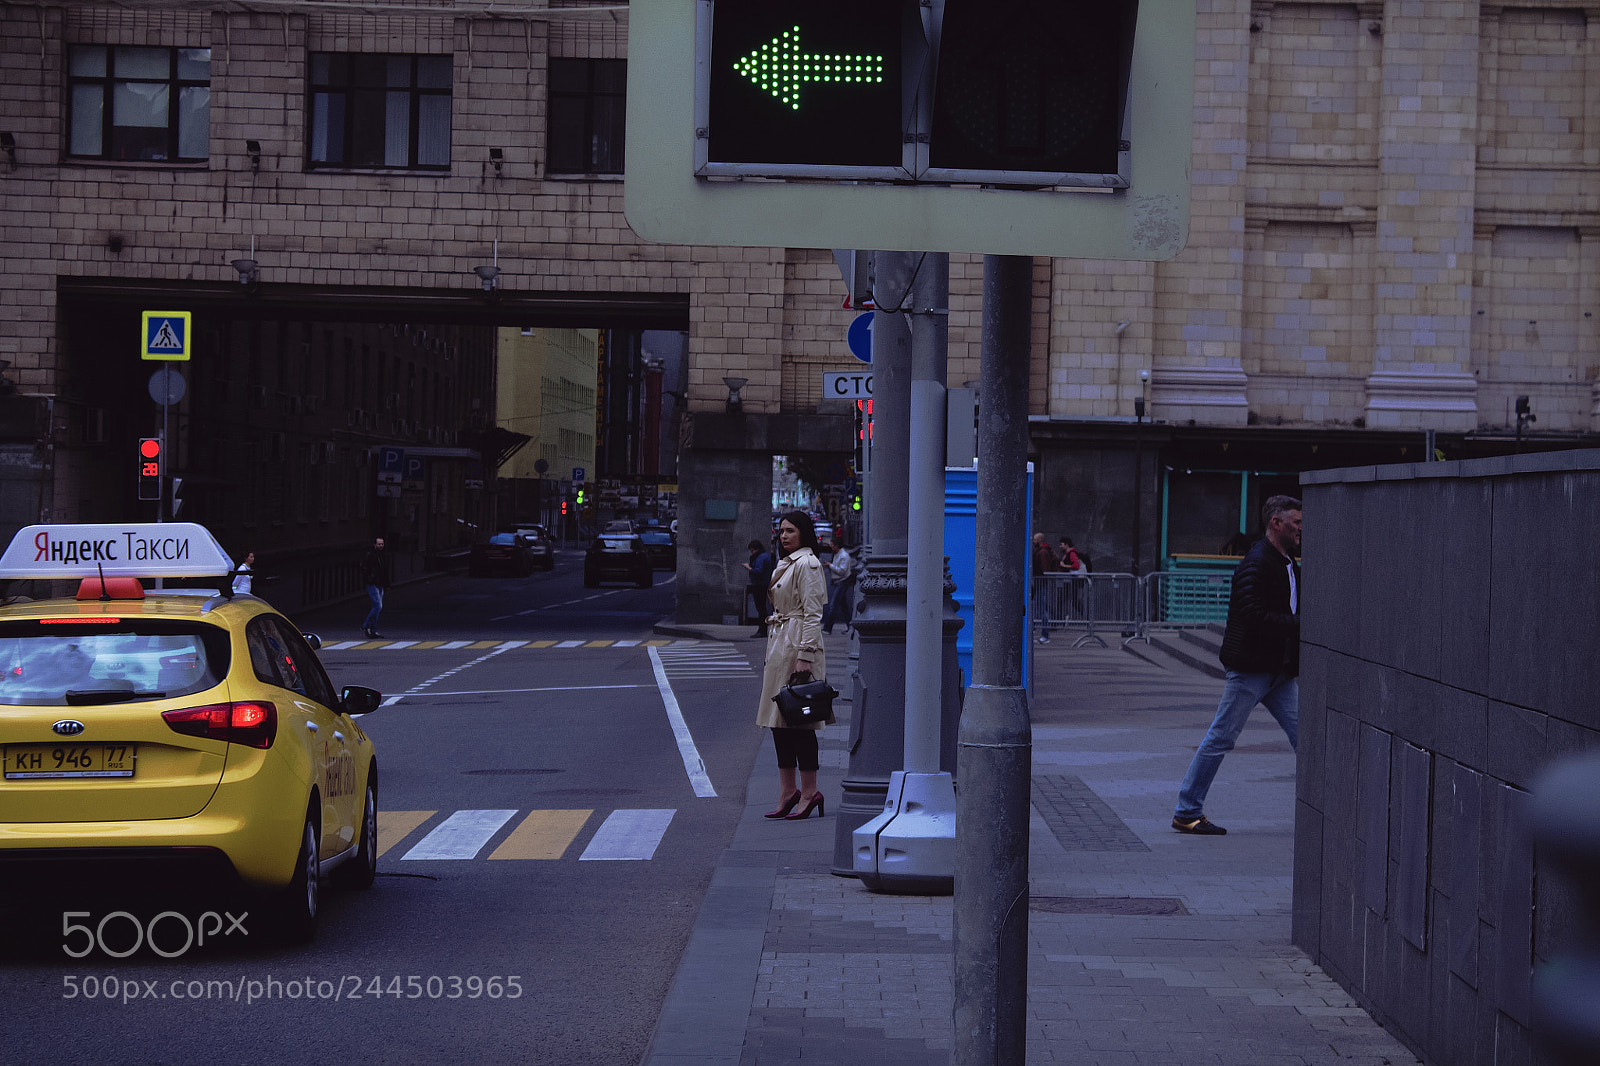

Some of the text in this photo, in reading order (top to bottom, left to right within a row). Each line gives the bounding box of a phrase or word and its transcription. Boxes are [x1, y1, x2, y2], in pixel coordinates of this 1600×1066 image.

[385, 450, 399, 469] P
[408, 459, 421, 476] P
[143, 462, 158, 476] 28
[34, 532, 190, 564] Яндекс Такси
[56, 721, 80, 733] KIA
[52, 748, 92, 769] 946
[106, 746, 127, 762] 77
